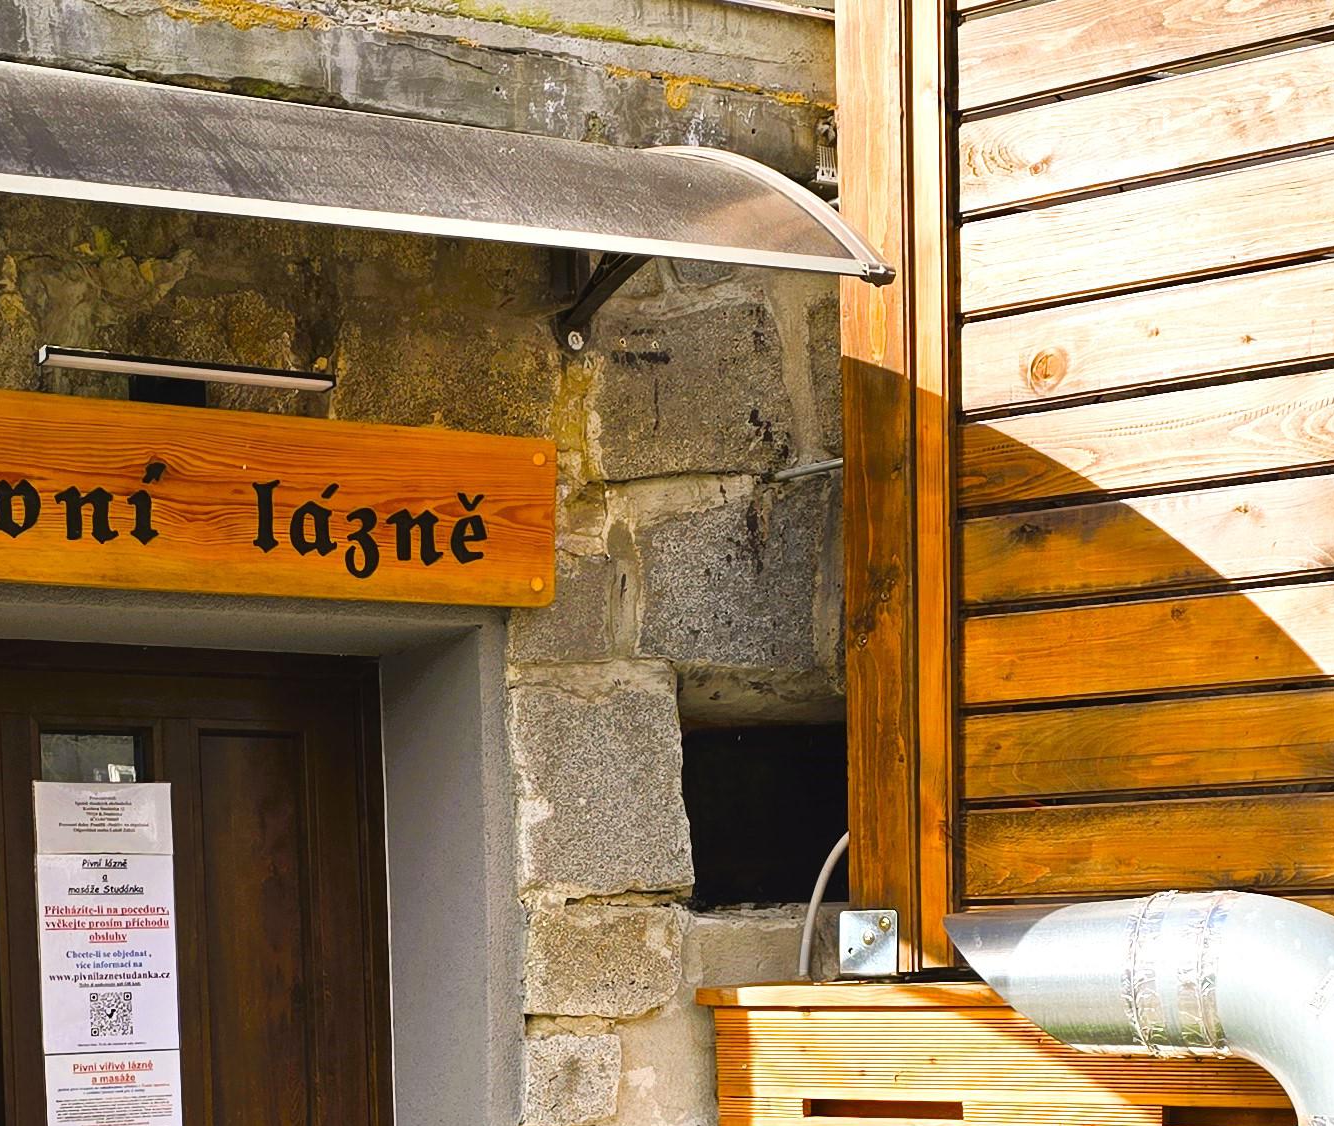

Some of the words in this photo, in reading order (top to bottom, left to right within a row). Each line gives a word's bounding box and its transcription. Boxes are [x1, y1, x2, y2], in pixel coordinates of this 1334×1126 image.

[252, 480, 489, 579] lázně
[82, 858, 102, 869] Pivní
[105, 858, 128, 869] lázně
[68, 885, 100, 895] masáže
[103, 884, 144, 894] Studánka
[44, 904, 104, 916] Přicházíte-li
[107, 906, 118, 915] na
[45, 919, 86, 930] vyčkejte
[88, 918, 123, 929] prosím
[126, 918, 170, 928] příchodu
[89, 932, 128, 943] obsluhy
[66, 950, 101, 958] Chcete-li
[113, 950, 147, 959] objednat
[76, 961, 91, 969] více
[49, 971, 171, 983] www.pivnilaznestudanka.cz
[100, 1073, 136, 1084] masáže
